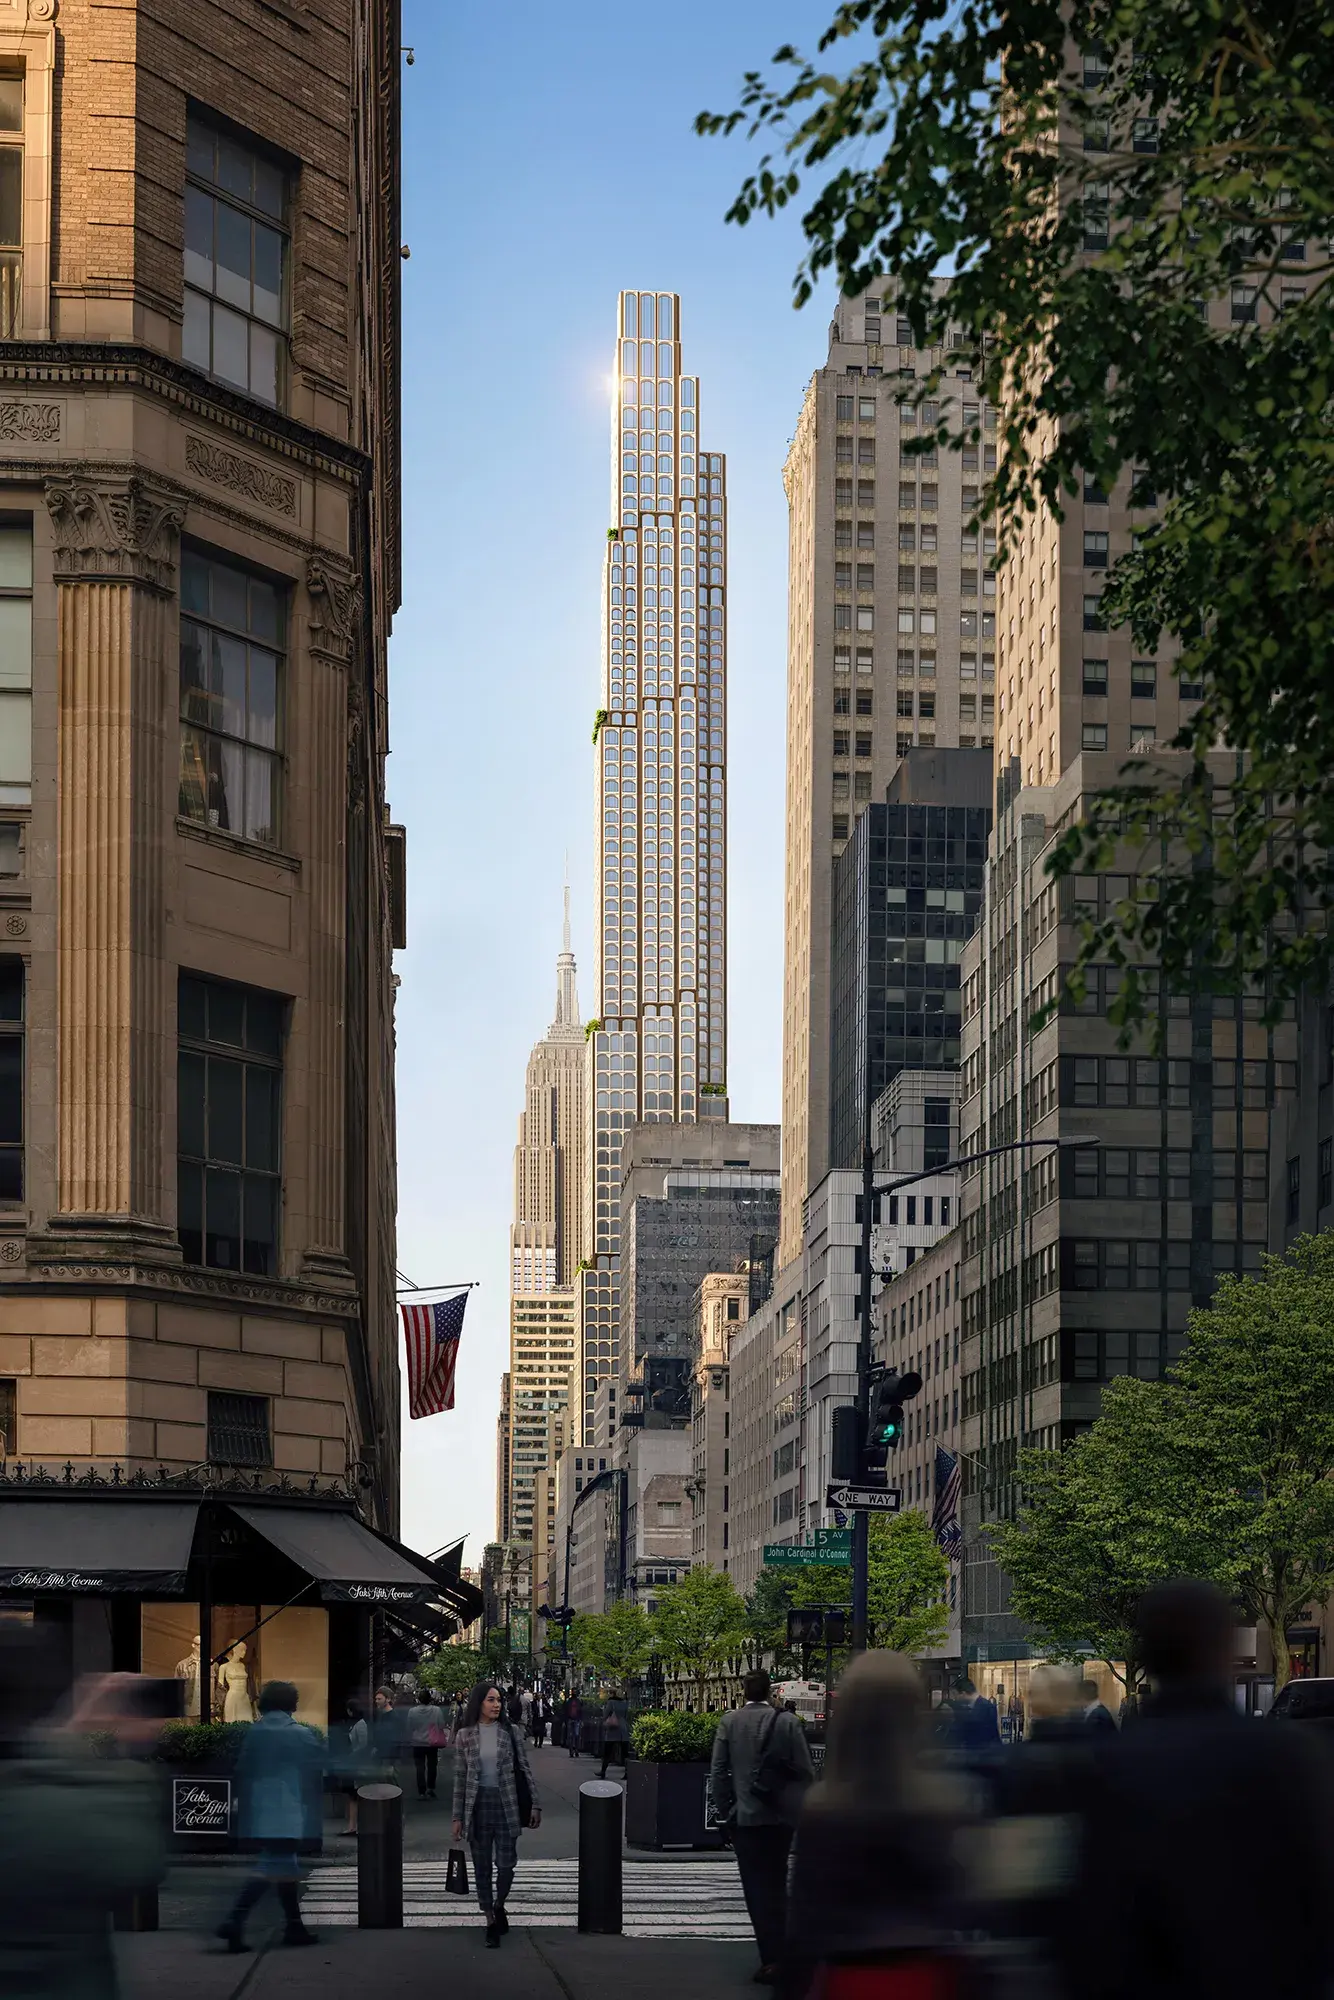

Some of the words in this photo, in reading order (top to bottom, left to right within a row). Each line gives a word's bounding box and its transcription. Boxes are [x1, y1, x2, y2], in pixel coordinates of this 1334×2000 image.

[838, 1493, 858, 1502] ONE
[868, 1494, 891, 1504] WAY
[819, 1531, 828, 1544] 5
[767, 1548, 784, 1557] John
[787, 1548, 816, 1558] Cardinal
[819, 1549, 849, 1559] O'Connor
[11, 1572, 41, 1586] Saks
[37, 1572, 65, 1586] Fifth
[59, 1573, 103, 1587] Avenue
[348, 1585, 370, 1599] Saks
[367, 1585, 387, 1599] Fifth
[383, 1586, 414, 1600] Avenue
[176, 1786, 210, 1806] Saks
[176, 1807, 224, 1826] Avenue
